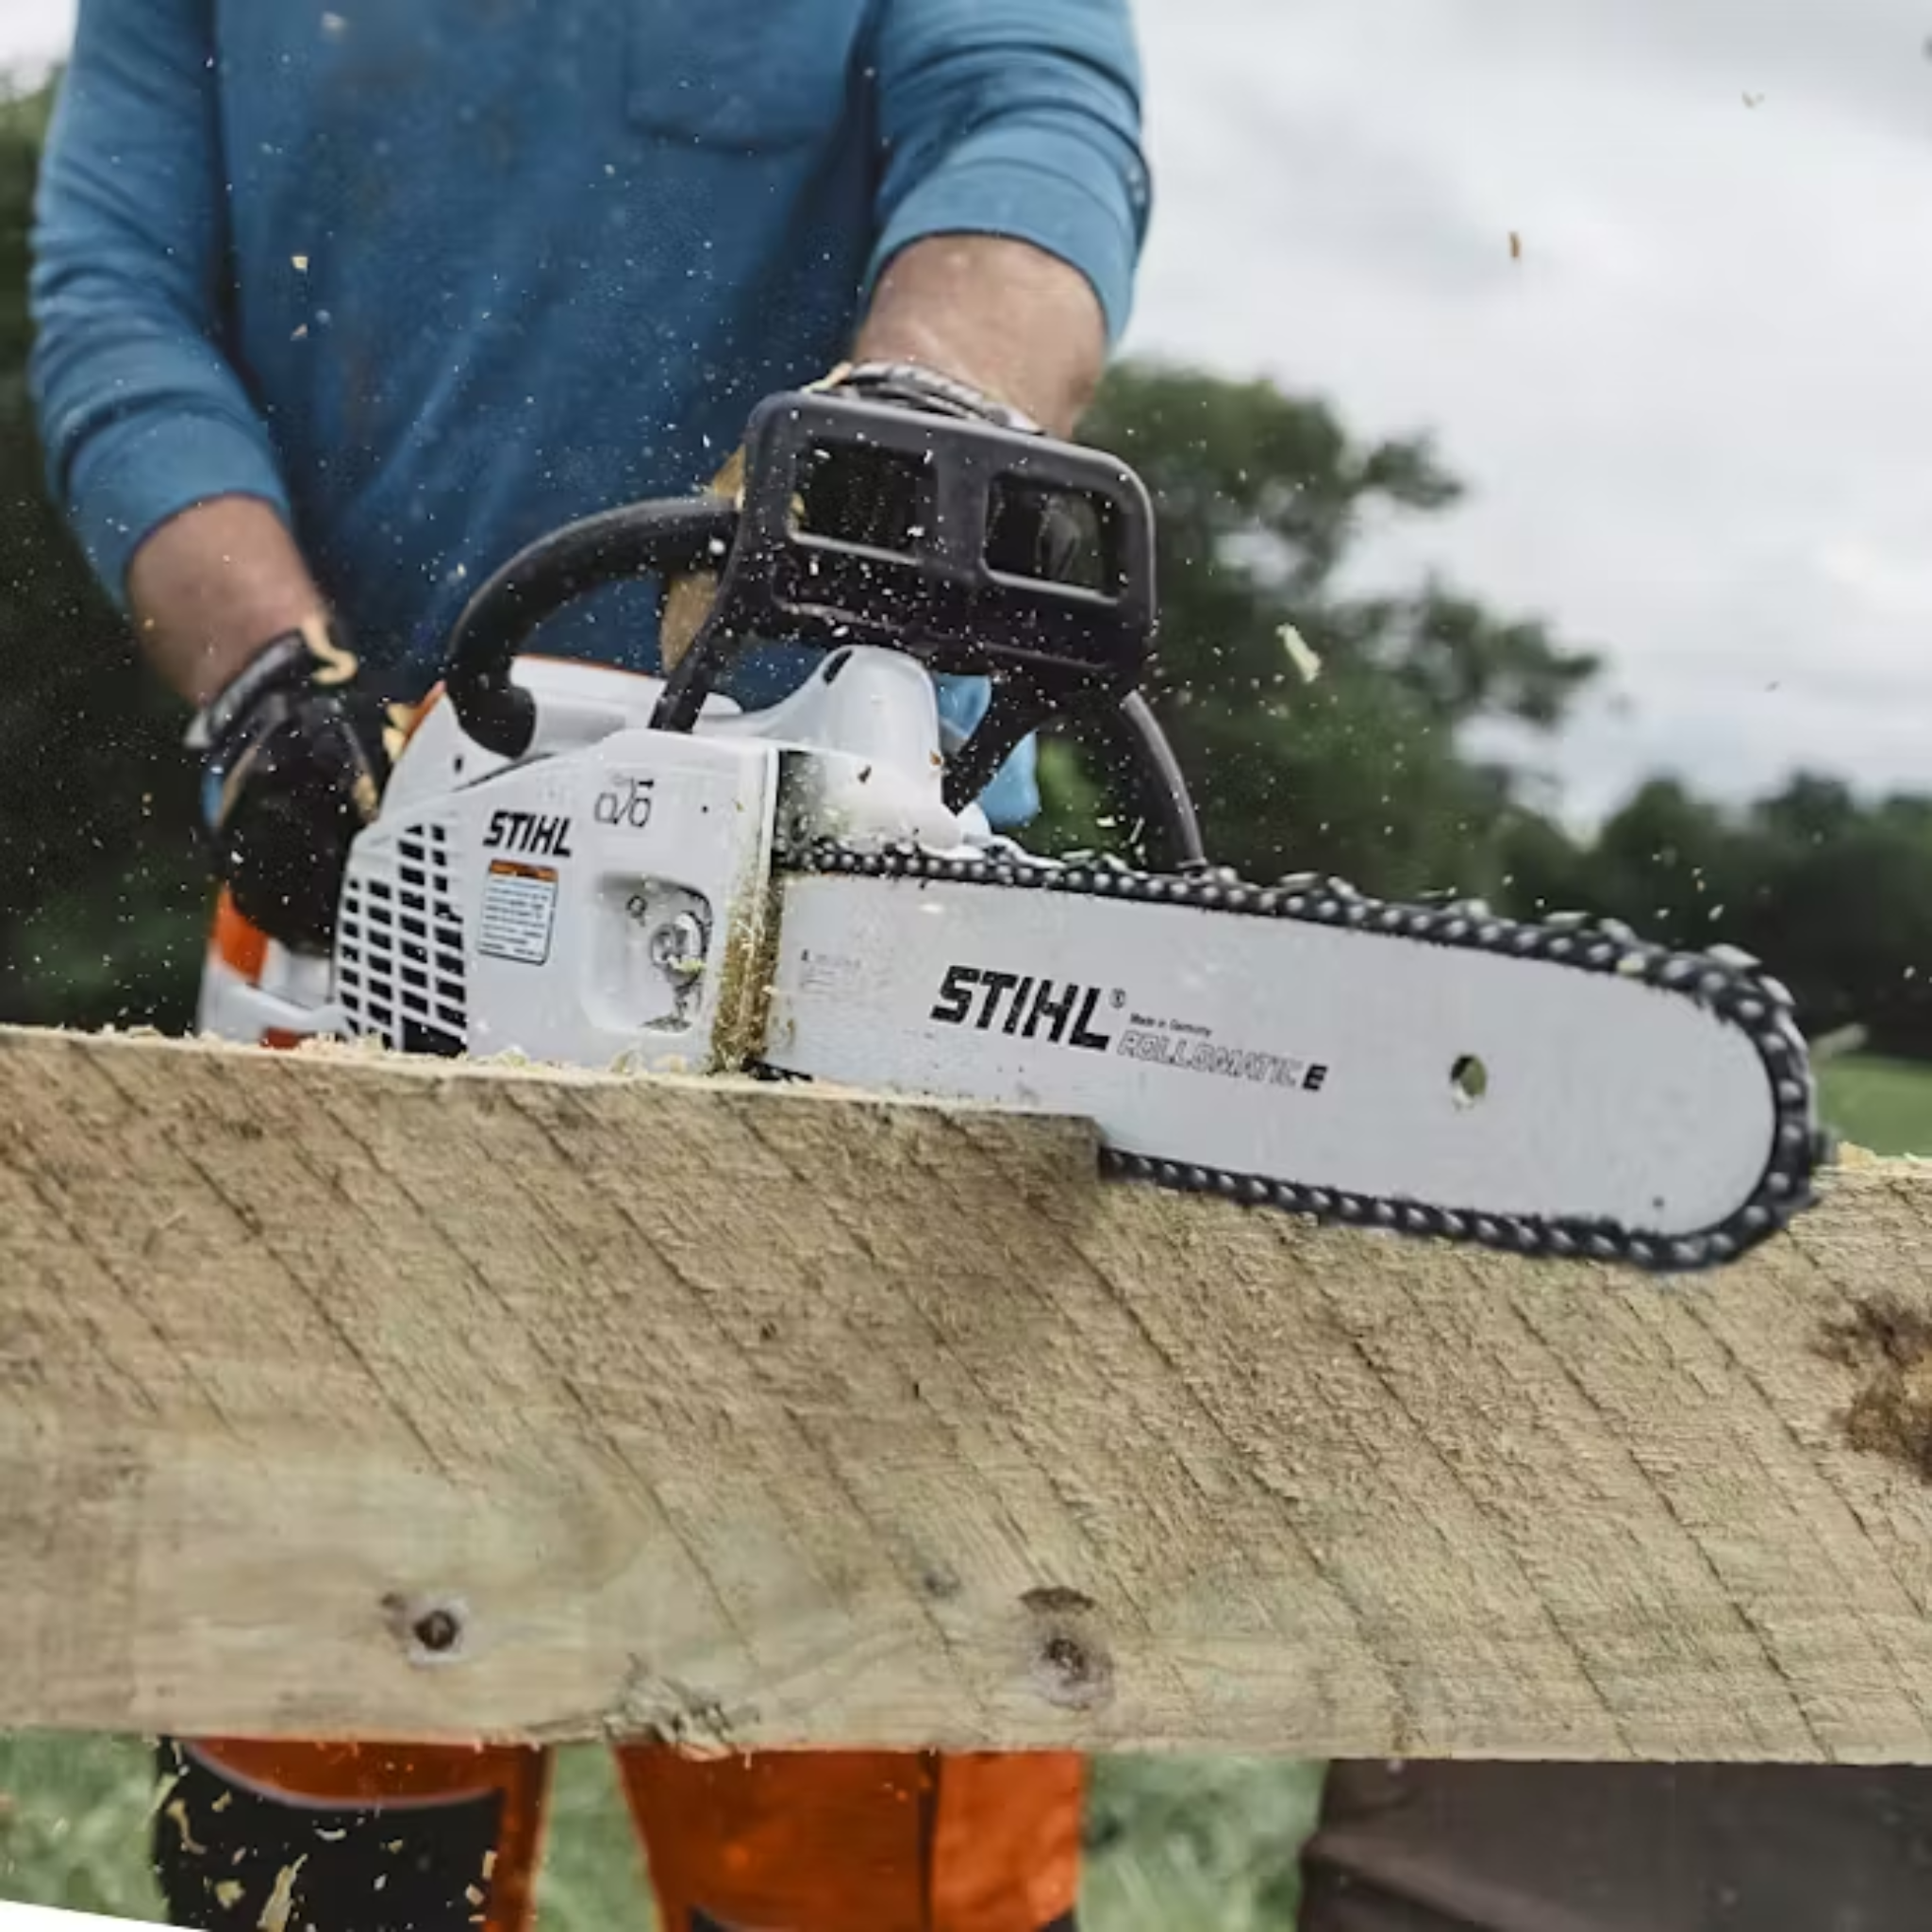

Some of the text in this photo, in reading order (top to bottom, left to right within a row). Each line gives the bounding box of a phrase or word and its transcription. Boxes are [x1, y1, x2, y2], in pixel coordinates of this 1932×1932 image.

[482, 809, 572, 858] STIHL
[929, 964, 1111, 1051] STIHL
[1301, 1062, 1328, 1091] E
